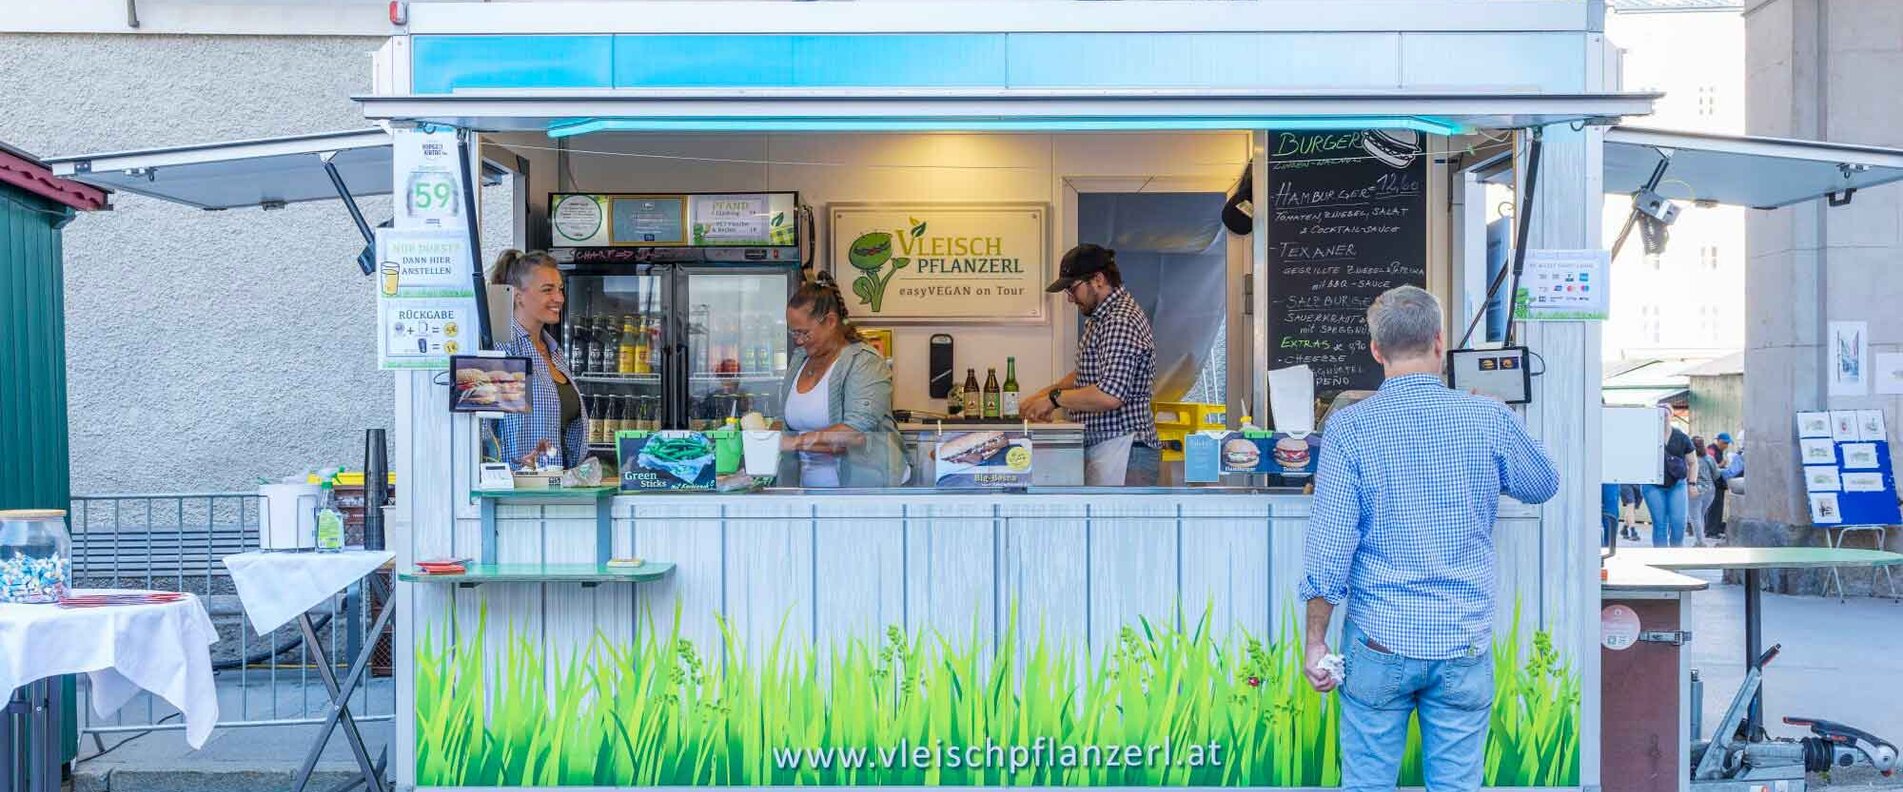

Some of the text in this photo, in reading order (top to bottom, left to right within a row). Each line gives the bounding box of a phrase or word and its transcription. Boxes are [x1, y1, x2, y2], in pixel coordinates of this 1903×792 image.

[416, 183, 450, 208] 59
[1275, 181, 1371, 206] HAMBURGER
[1372, 207, 1409, 216] SALAT
[895, 230, 1002, 256] VLEISCH
[1279, 242, 1357, 258] TEXANER
[402, 256, 451, 264] DANN HIER
[917, 258, 1024, 273] PFLANZERL
[899, 286, 1025, 299] easyVEGAN on Tour
[399, 310, 454, 319] RÜCKGABE
[1280, 336, 1331, 349] EXTRAS
[1316, 375, 1350, 386] PEÑO
[624, 471, 657, 480] Green
[640, 479, 667, 488] Sticks
[773, 737, 1222, 774] www.vleischpflanzerl.at
